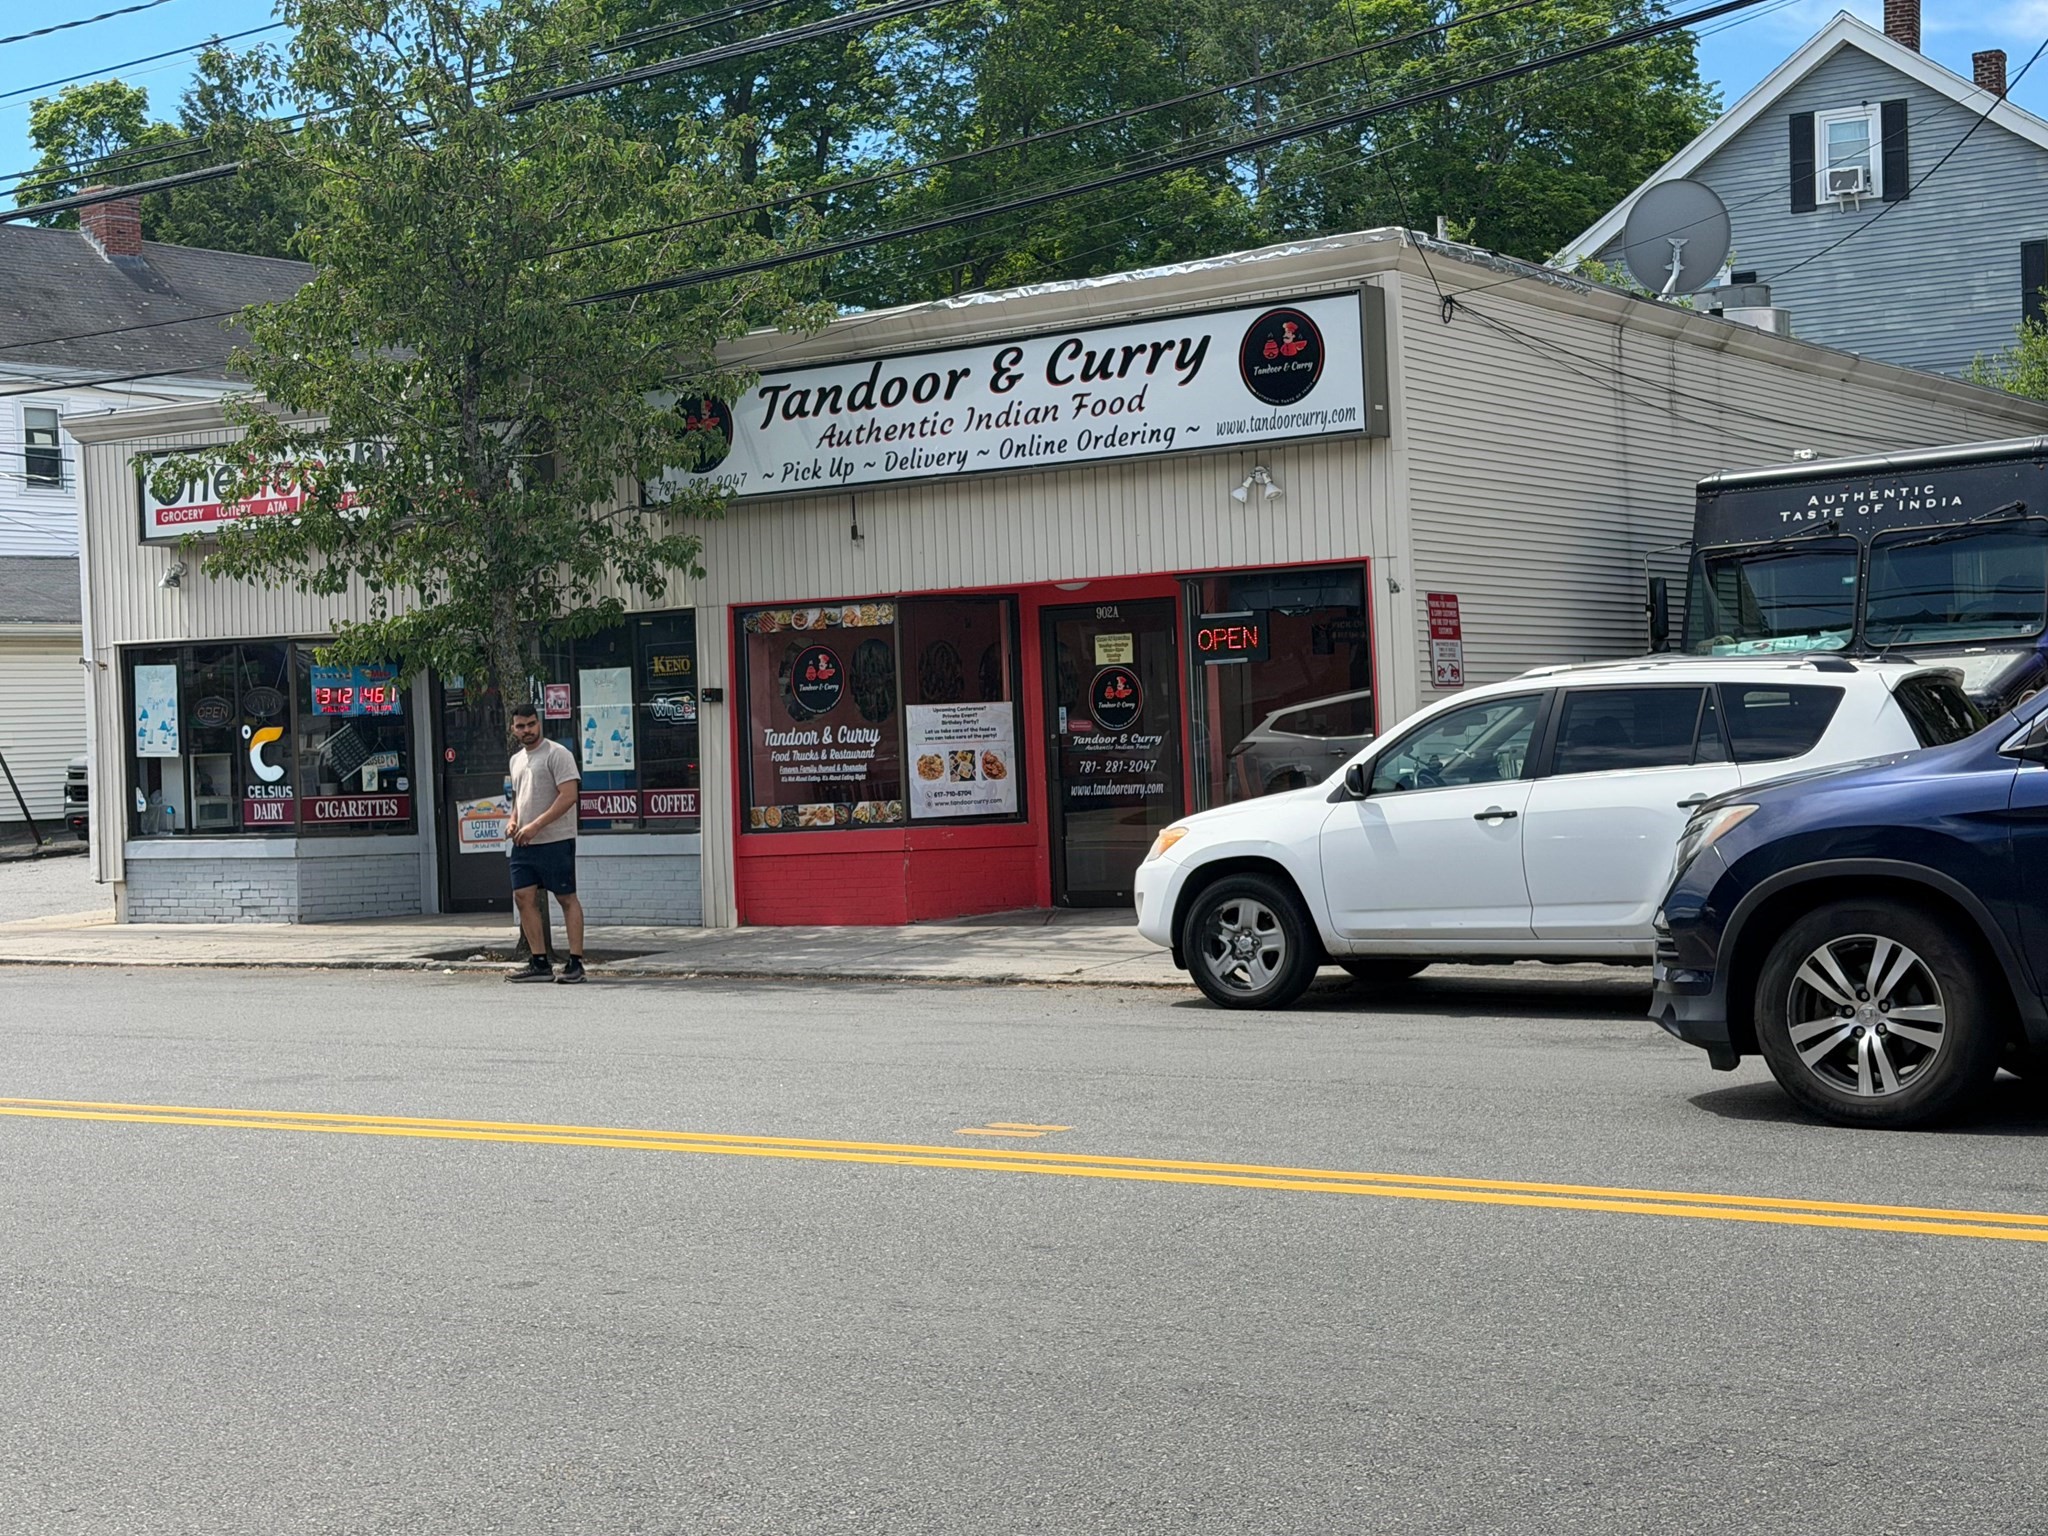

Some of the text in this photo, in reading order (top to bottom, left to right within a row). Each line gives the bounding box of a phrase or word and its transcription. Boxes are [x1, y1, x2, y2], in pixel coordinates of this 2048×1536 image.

[1253, 364, 1282, 376] Tandoor
[1291, 361, 1313, 373] Curry
[759, 334, 1212, 430] Tandoor & Curry
[816, 383, 1149, 449] Authentic Indian Food
[1216, 406, 1357, 437] www.tandoorcurry.com
[781, 458, 821, 484] Pick
[829, 457, 855, 484] Up
[885, 447, 969, 472] Delivery
[999, 433, 1068, 460] Online
[1077, 424, 1176, 451] Ordering
[1807, 484, 1935, 507] AUTHENTIC
[161, 509, 203, 524] GROCERY
[266, 500, 288, 514] ATM
[1780, 496, 1963, 522] TASTE OF INDIA
[1096, 606, 1119, 619] 902A
[1198, 626, 1258, 650] OPEN
[652, 655, 691, 673] KENO
[197, 706, 229, 719] OPEN
[764, 725, 880, 747] Tandoor & Curry
[1073, 733, 1162, 746] Tandoor & Curry
[771, 748, 875, 762] Food Trucks & Restaurant
[1079, 759, 1157, 774] 781- 281-2047
[248, 785, 293, 799] CELSIUS
[1070, 779, 1164, 799] www.tandoorcurry.com
[253, 803, 284, 820] DAIRY
[315, 800, 398, 818] CIGARETTES
[598, 795, 637, 814] CARDS
[651, 793, 696, 813] COFFEE
[471, 820, 500, 830] LOTTERY
[474, 829, 498, 839] GAMES
